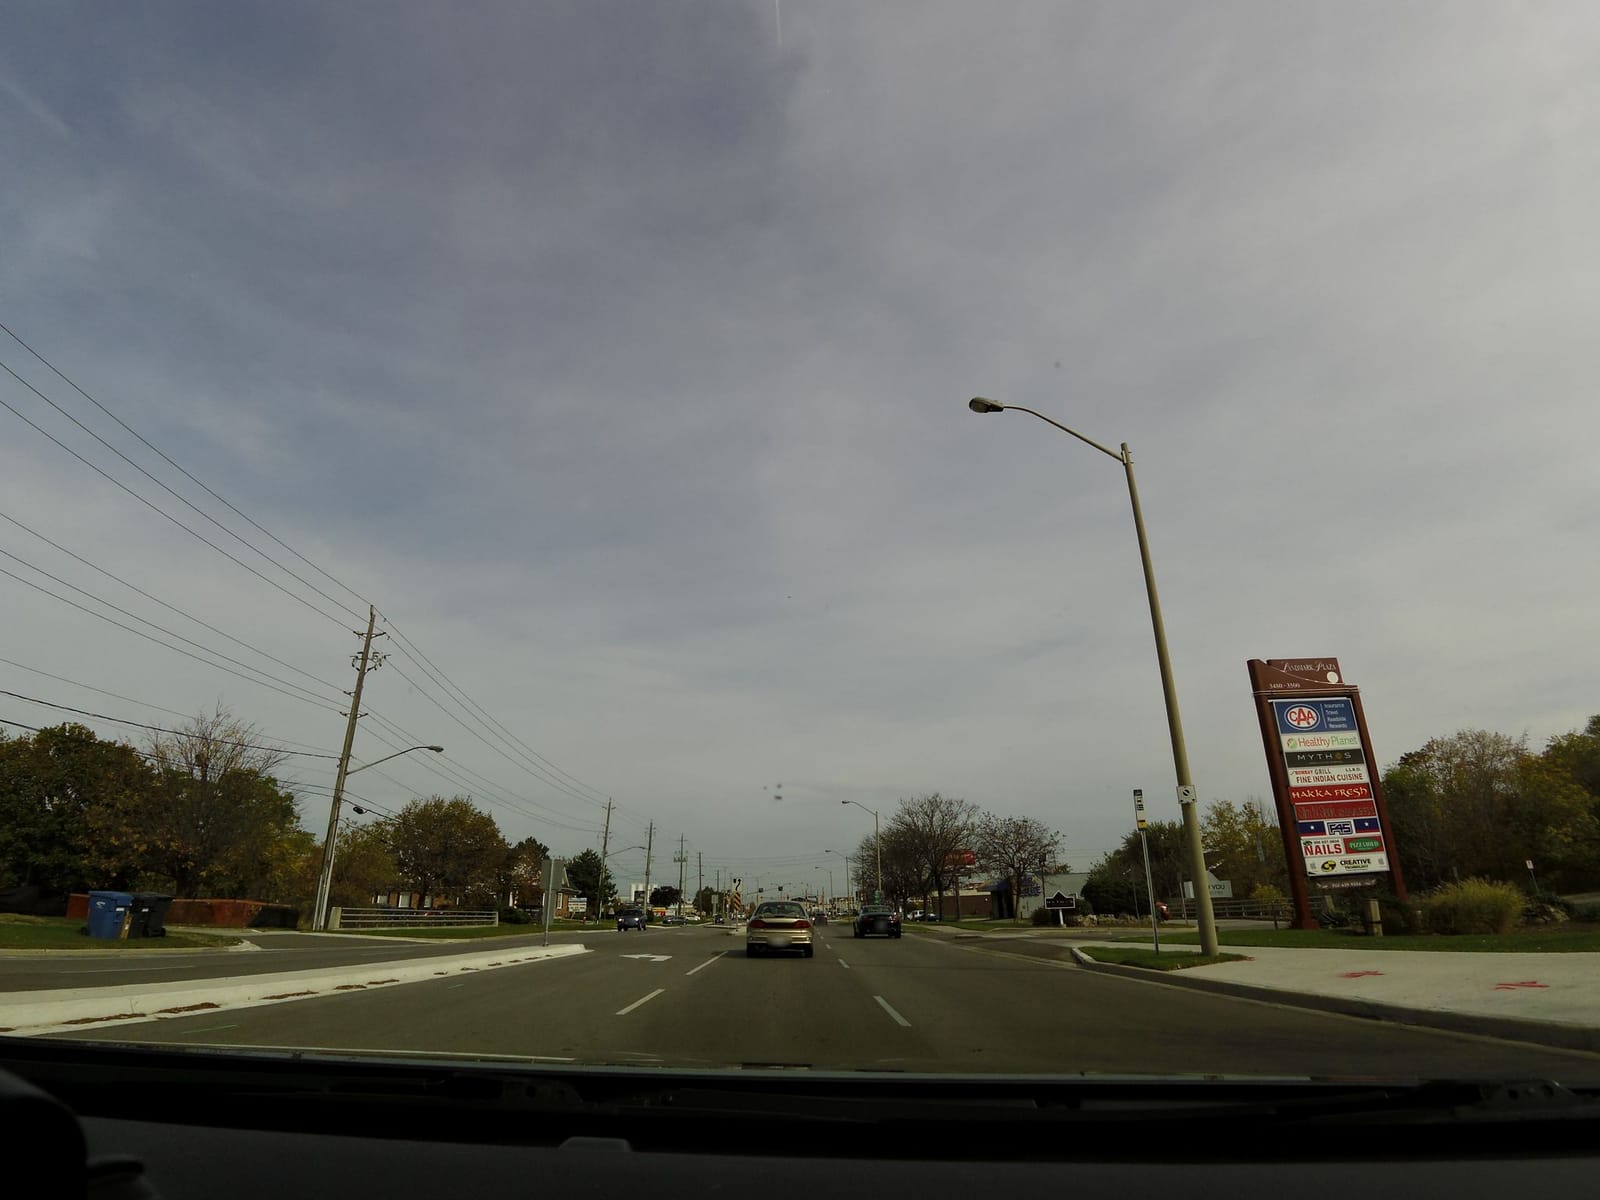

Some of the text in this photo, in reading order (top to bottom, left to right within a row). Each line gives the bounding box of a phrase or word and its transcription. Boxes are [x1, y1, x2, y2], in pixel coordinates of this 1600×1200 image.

[1289, 708, 1316, 726] CAA
[1298, 735, 1358, 748] Healthy Planet
[1296, 773, 1363, 784] FINE INDIAN CUISINE
[1291, 789, 1332, 799] HAKKA
[1328, 823, 1352, 835] F45
[1304, 843, 1342, 856] NAILS
[1339, 858, 1372, 866] CREATIVE
